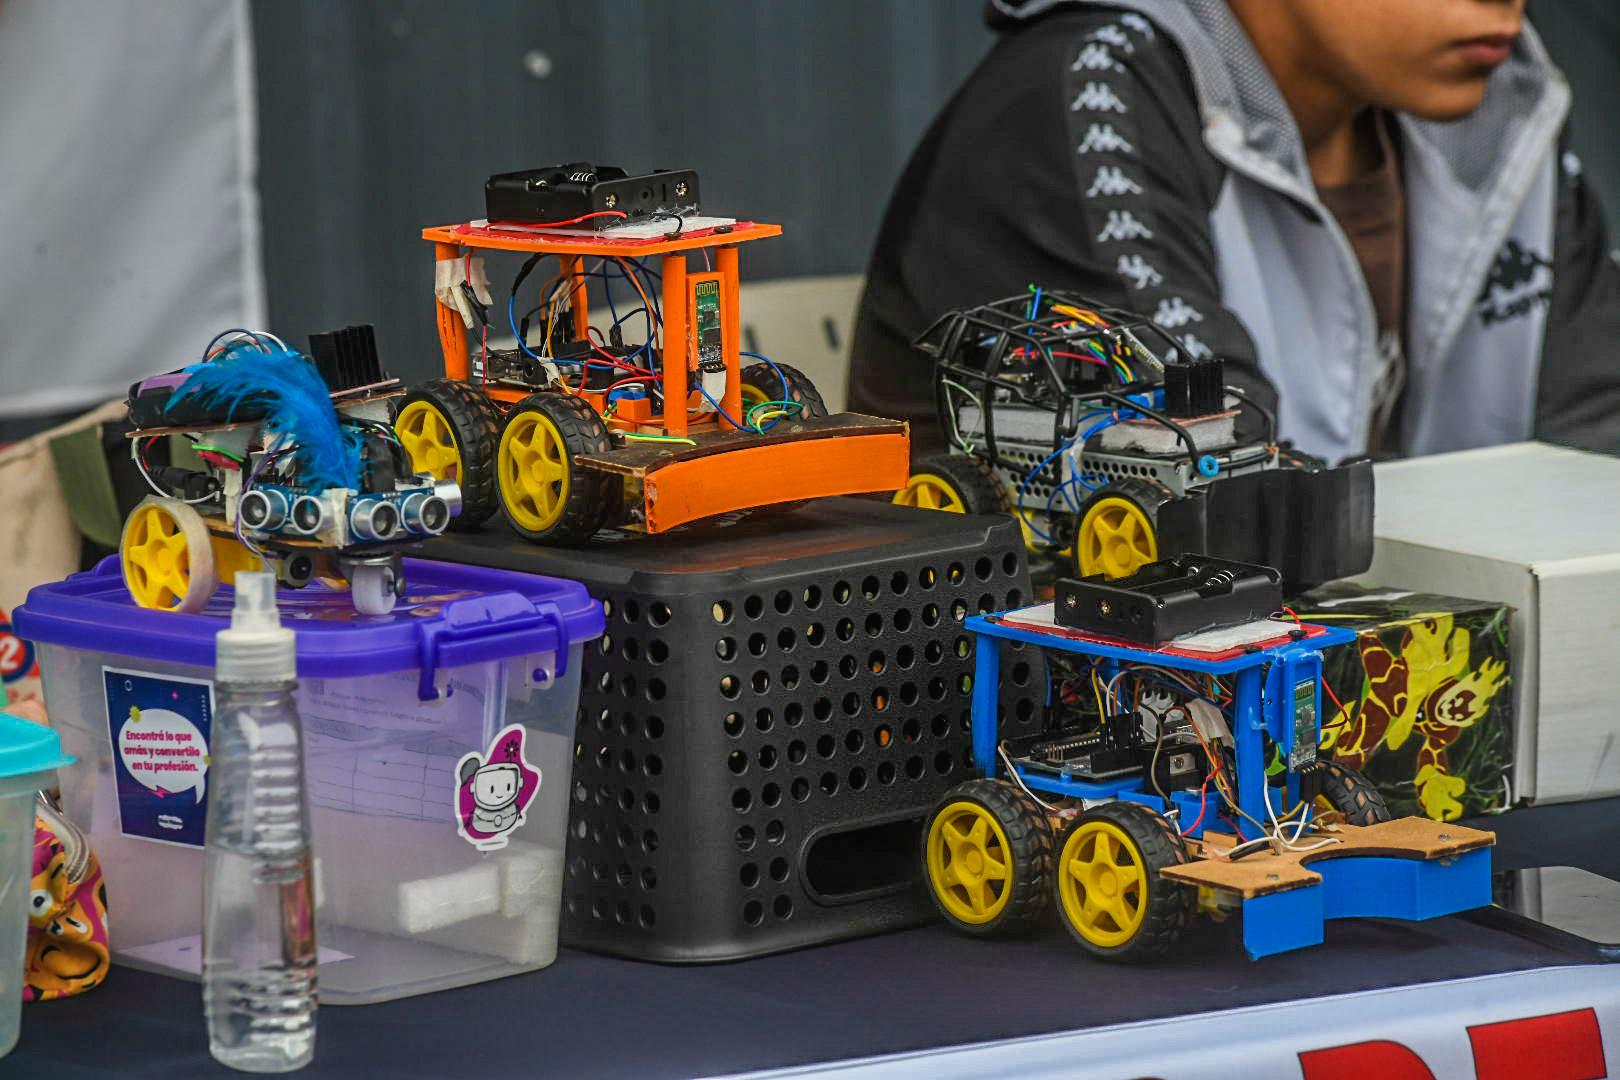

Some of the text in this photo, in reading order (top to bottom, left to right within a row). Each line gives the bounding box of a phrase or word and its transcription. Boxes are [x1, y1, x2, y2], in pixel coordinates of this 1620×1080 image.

[126, 730, 192, 744] Encontrá lo que
[124, 744, 200, 759] amás y convertilo
[132, 760, 199, 774] en tu profesión.
